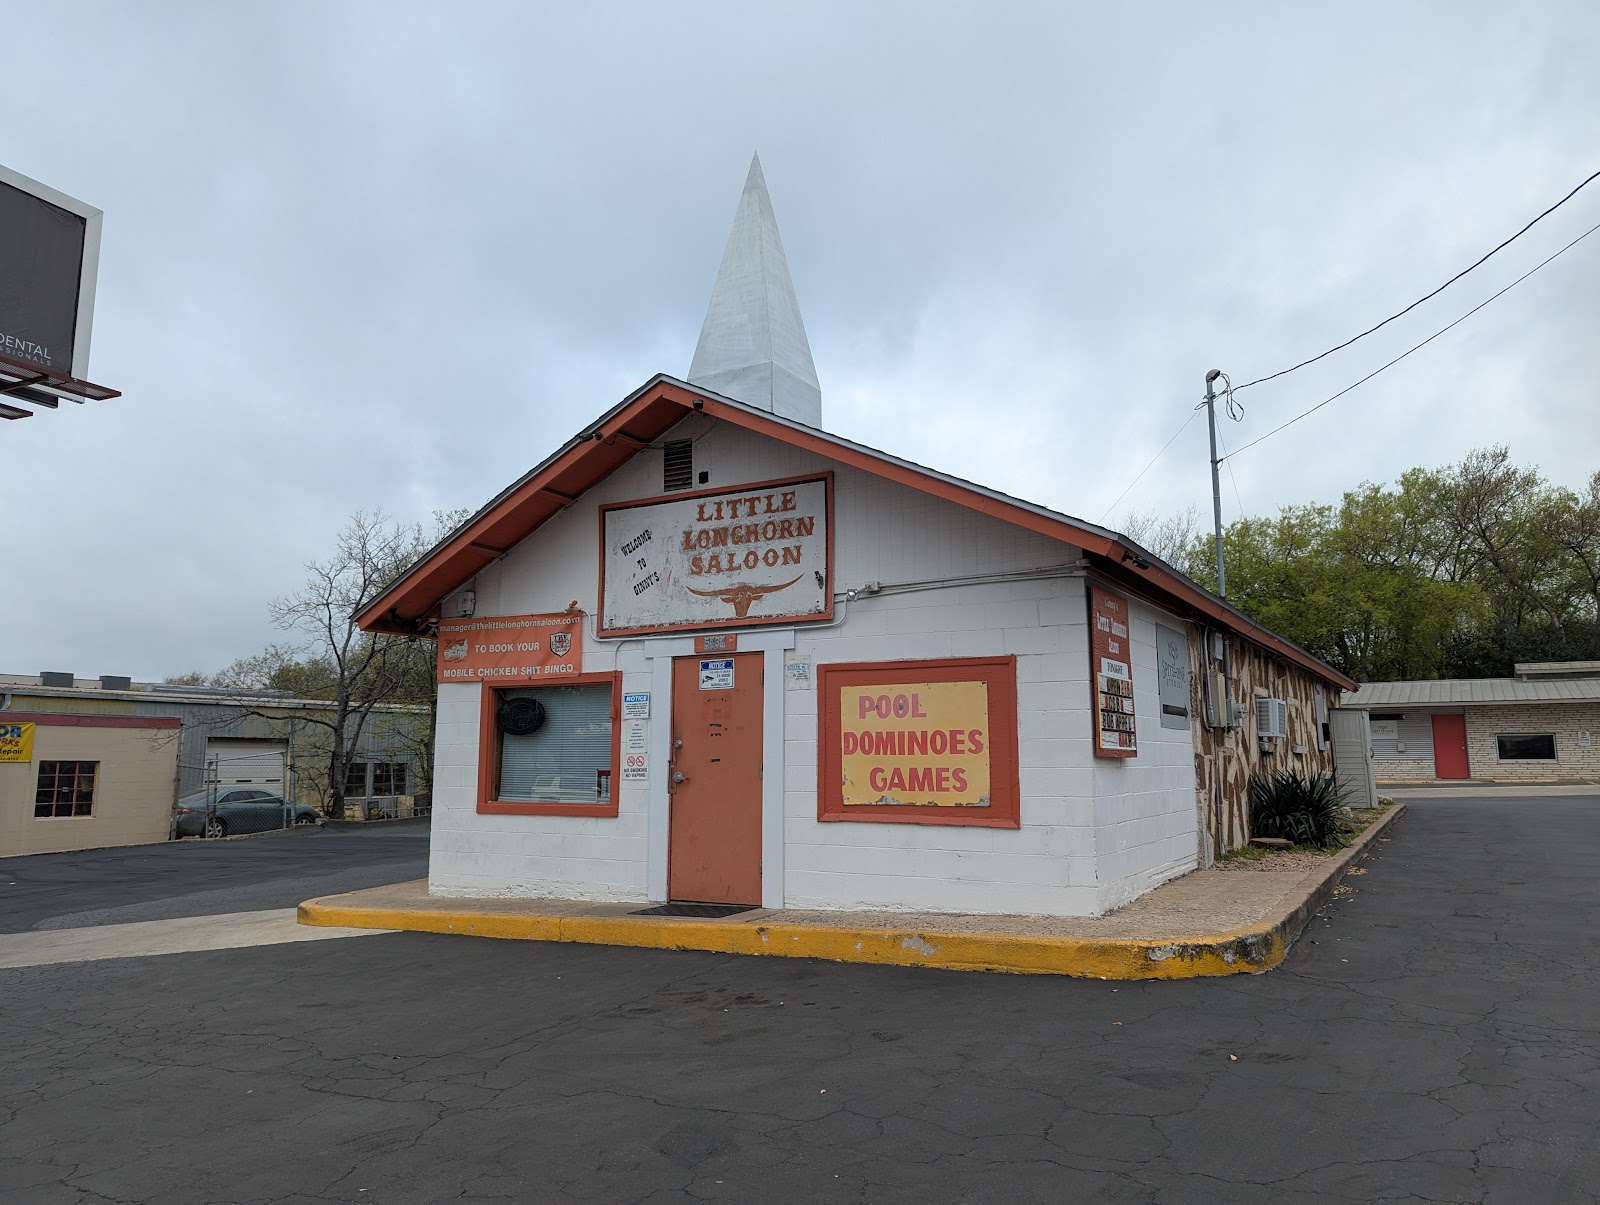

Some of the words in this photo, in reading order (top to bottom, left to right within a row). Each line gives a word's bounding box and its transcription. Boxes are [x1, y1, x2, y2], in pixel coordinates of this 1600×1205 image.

[696, 490, 797, 522] LITTLE
[621, 529, 652, 557] WELCOME
[682, 515, 815, 550] LONGHORN
[637, 557, 647, 570] TO
[690, 545, 802, 576] SALOON
[633, 571, 660, 596] GINNY'S
[440, 616, 580, 632] manager@thelittlelonghornsaloon.com
[474, 644, 487, 653] TO
[489, 643, 514, 653] BOOK
[517, 642, 540, 651] YOUR
[443, 668, 474, 678] MOBILE
[478, 667, 518, 677] CHICKEN
[521, 665, 541, 675] SHIT
[544, 663, 574, 674] BINGO
[709, 661, 726, 669] NOTICE
[858, 693, 928, 720] POOL
[1102, 713, 1114, 728] BOB
[0, 737, 20, 747] RKS
[843, 729, 984, 756] DOMINOES
[869, 767, 968, 793] GAMES
